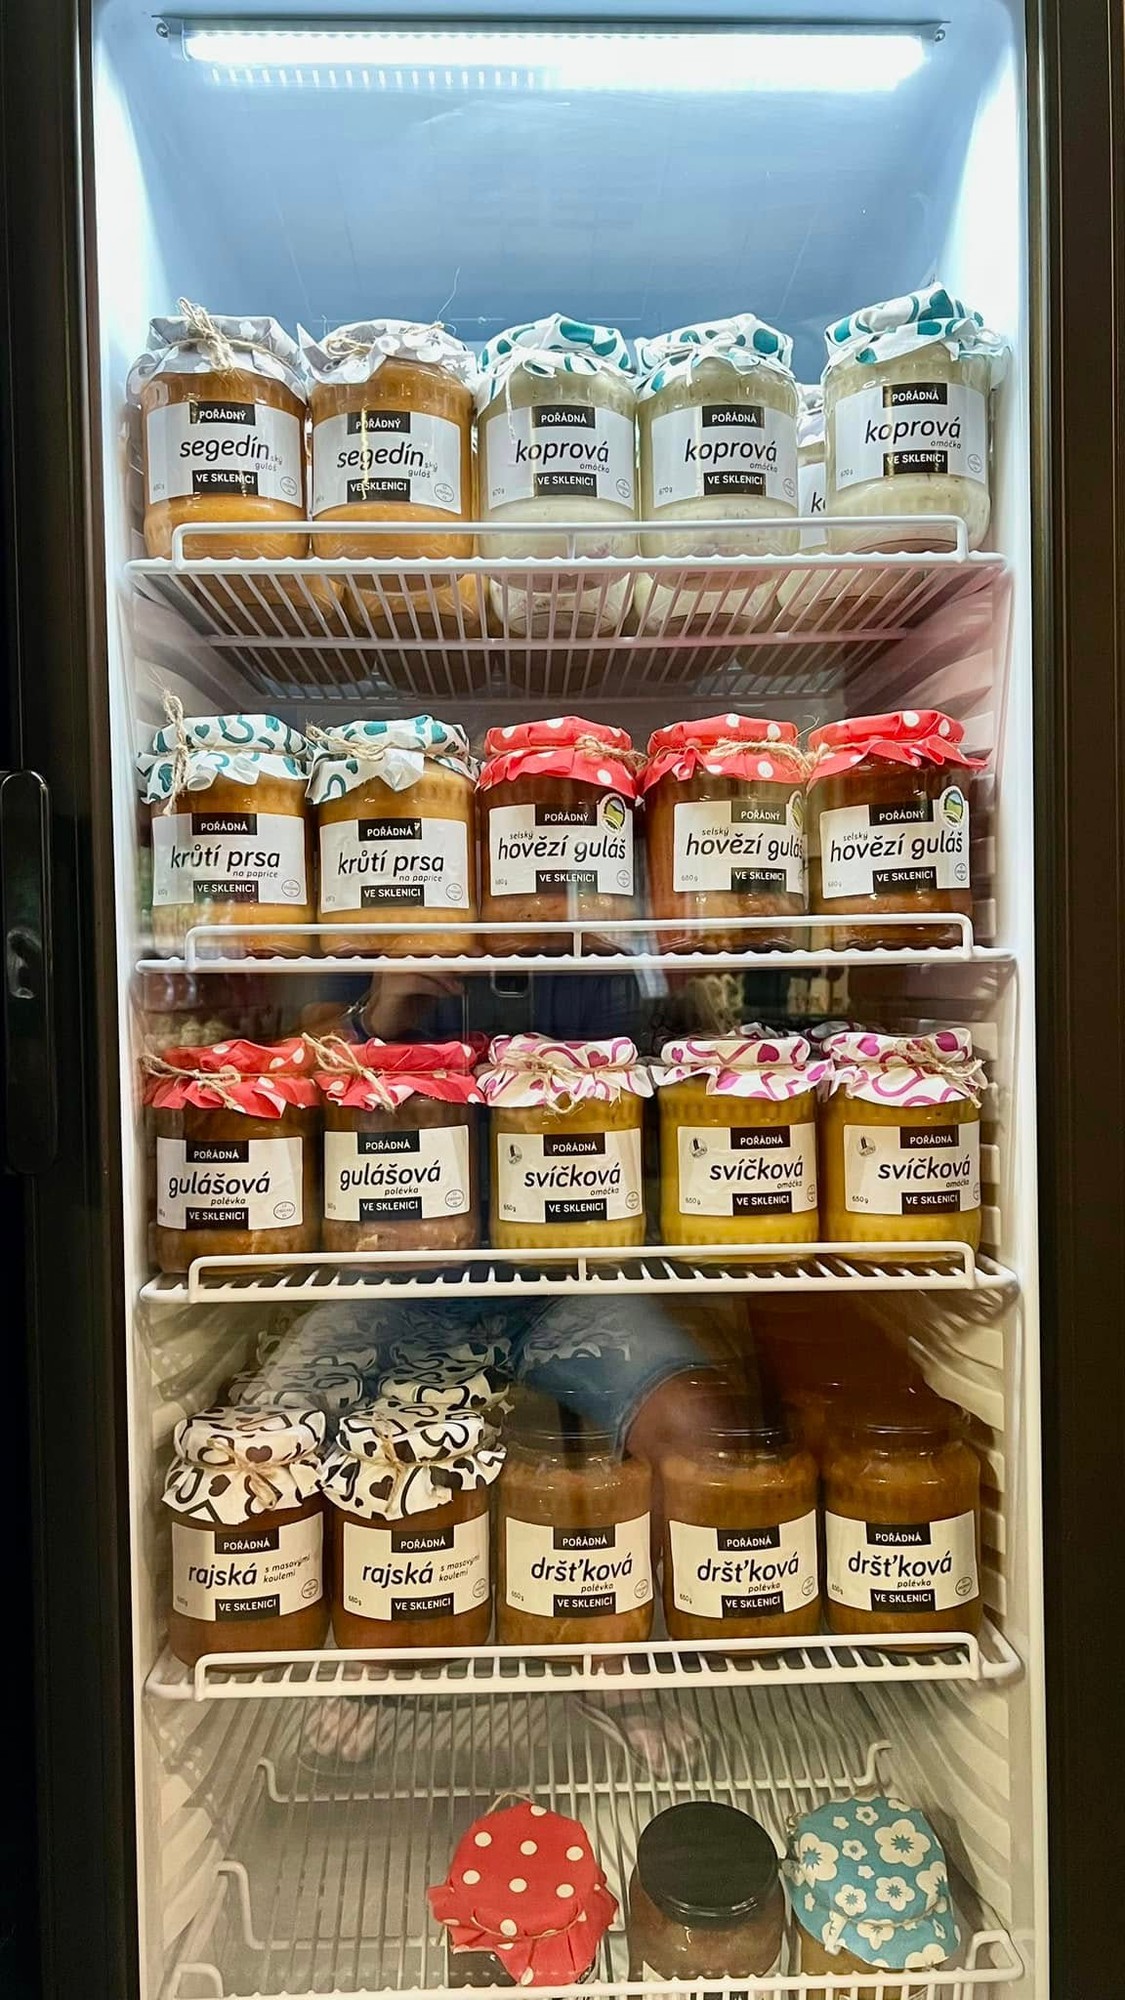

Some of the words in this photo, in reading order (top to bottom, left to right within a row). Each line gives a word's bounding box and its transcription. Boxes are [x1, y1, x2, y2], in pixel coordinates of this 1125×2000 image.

[891, 389, 940, 402] POŘÁDNÁ
[199, 408, 247, 421] POŘÁDNÝ
[541, 412, 587, 424] POŘÁDNÁ
[711, 411, 757, 424] POŘÁDNÁ
[864, 416, 961, 445] koprová
[515, 439, 610, 466] koprová
[684, 438, 777, 465] koprová
[886, 453, 899, 465] VE
[901, 453, 945, 464] SKLENICI
[195, 474, 208, 483] VE
[211, 473, 255, 485] SKLENICI
[537, 476, 550, 485] VE
[552, 475, 594, 487] SKLENICI
[707, 475, 720, 485] VE
[722, 474, 763, 486] SKLENICI
[350, 483, 363, 492] VE
[366, 482, 407, 492] SKLENICI
[544, 811, 589, 822] POŘÁDNÝ
[740, 810, 781, 821] POŘÁDNÝ
[879, 809, 925, 821] POŘÁDNÝ
[200, 820, 248, 832] POŘÁDNÁ
[367, 826, 413, 837] POŘÁDNÁ
[498, 835, 569, 860] hovězí
[574, 835, 626, 863] guláš
[685, 833, 764, 857] hovězí
[830, 833, 906, 863] hovězí
[911, 830, 963, 860] guláš
[170, 844, 222, 869] krůtí
[226, 850, 281, 873] prsa
[337, 850, 388, 876] krůtí
[392, 855, 445, 878] prsa
[246, 870, 279, 879] paprice
[412, 875, 443, 883] paprice
[539, 874, 552, 883] VE
[554, 873, 595, 883] SKLENICI
[734, 871, 747, 880] VE
[749, 871, 785, 881] SKLENICI
[876, 873, 889, 882] VE
[891, 870, 934, 882] SKLENICI
[196, 884, 209, 893] VE
[211, 883, 256, 893] SKLENICI
[363, 889, 376, 898] VE
[378, 888, 421, 898] SKLENICI
[365, 1138, 411, 1150] POŘÁDNÁ
[740, 1134, 784, 1146] POŘÁDNÁ
[909, 1133, 953, 1145] POŘÁDNÁ
[552, 1141, 598, 1153] POŘÁDNÁ
[193, 1148, 239, 1160] POŘÁDNÁ
[709, 1155, 804, 1181] svíčková
[877, 1154, 971, 1180] svíčková
[339, 1160, 441, 1192] gulášová
[524, 1162, 621, 1188] svíčková
[168, 1171, 271, 1199] gulášová
[384, 1186, 419, 1197] polévka
[210, 1197, 246, 1207] polévka
[736, 1197, 749, 1206] VE
[751, 1195, 790, 1206] SKLENICI
[905, 1196, 918, 1205] VE
[920, 1194, 958, 1205] SKLENICI
[362, 1202, 374, 1212] VE
[375, 1200, 419, 1211] SKLENICI
[548, 1204, 561, 1214] VE
[563, 1202, 604, 1213] SKLENICI
[189, 1211, 200, 1221] VE
[202, 1211, 245, 1221] SKLENICI
[400, 1535, 446, 1550] POŘÁDNÁ
[562, 1534, 608, 1547] POŘÁDNÁ
[726, 1535, 772, 1548] POŘÁDNÁ
[875, 1531, 922, 1543] POŘÁDNÁ
[223, 1537, 271, 1551] POŘÁDNÁ
[271, 1554, 311, 1572] masovými
[446, 1554, 480, 1571] masovými
[530, 1552, 633, 1582] dršťková
[697, 1551, 799, 1583] dršťková
[848, 1550, 952, 1578] dršťková
[188, 1562, 258, 1590] rajská
[263, 1570, 296, 1584] koulemi
[362, 1561, 434, 1589] rajská
[438, 1568, 469, 1582] koulemi
[580, 1583, 614, 1594] polévka
[747, 1582, 781, 1594] polévka
[897, 1579, 932, 1589] polévka
[394, 1602, 408, 1611] VE
[410, 1598, 451, 1611] SKLENICI
[557, 1599, 570, 1608] VE
[571, 1597, 613, 1609] SKLENICI
[725, 1599, 738, 1609] VE
[739, 1596, 781, 1609] SKLENICI
[874, 1593, 886, 1603] VE
[888, 1593, 932, 1604] SKLENICI
[218, 1603, 231, 1612] VE
[233, 1599, 277, 1611] SKLENICI
